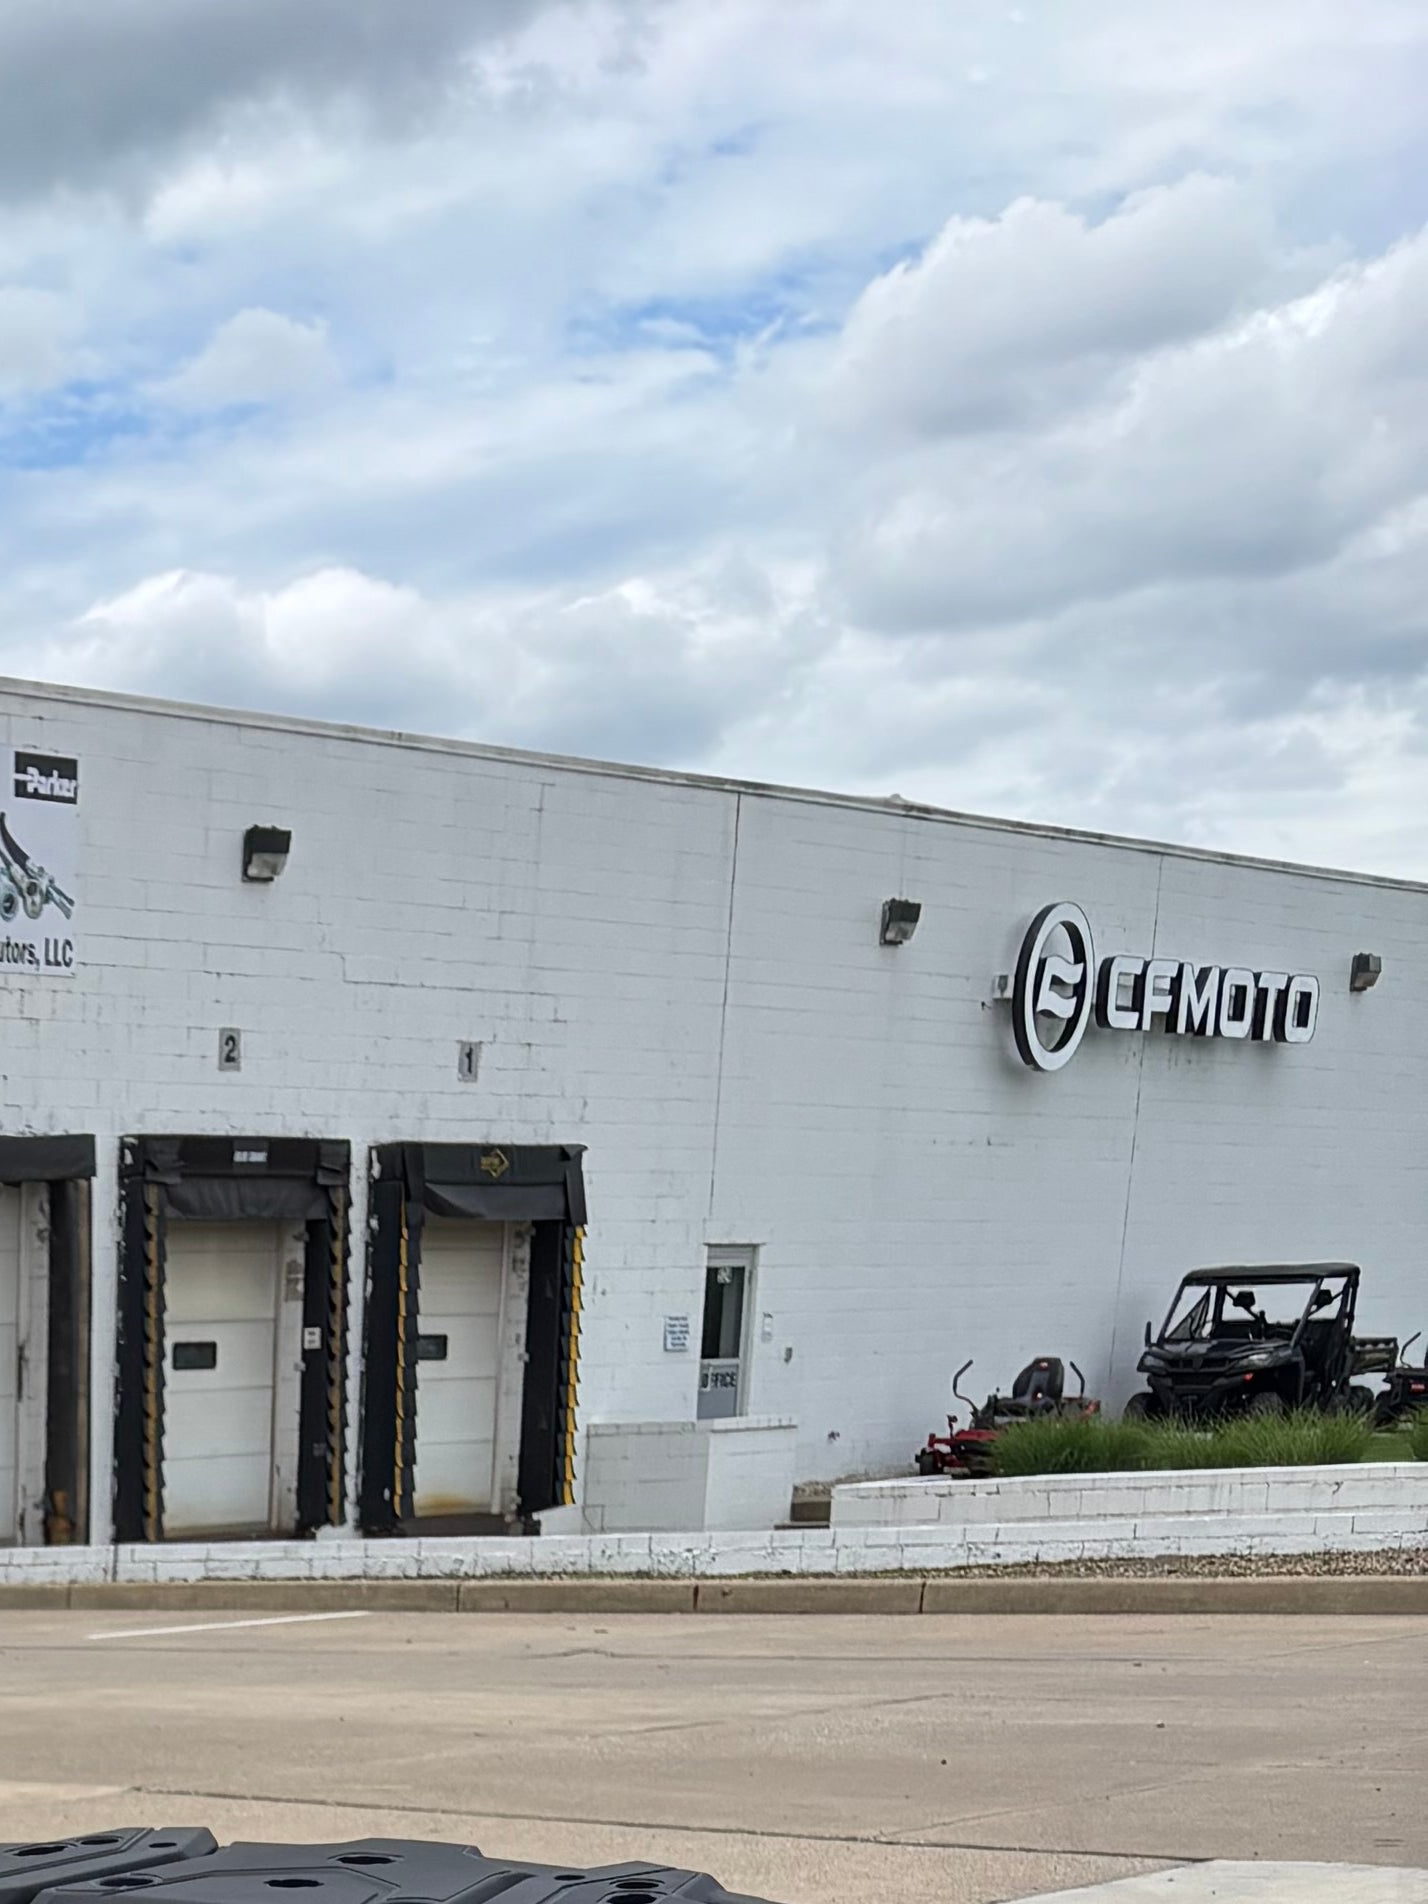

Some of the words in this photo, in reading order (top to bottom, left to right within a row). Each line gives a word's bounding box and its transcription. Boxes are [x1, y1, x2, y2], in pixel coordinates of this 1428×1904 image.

[44, 937, 75, 968] LLC
[1098, 955, 1319, 1043] CFMOTO
[224, 1035, 237, 1064] 2
[463, 1047, 474, 1075] 1
